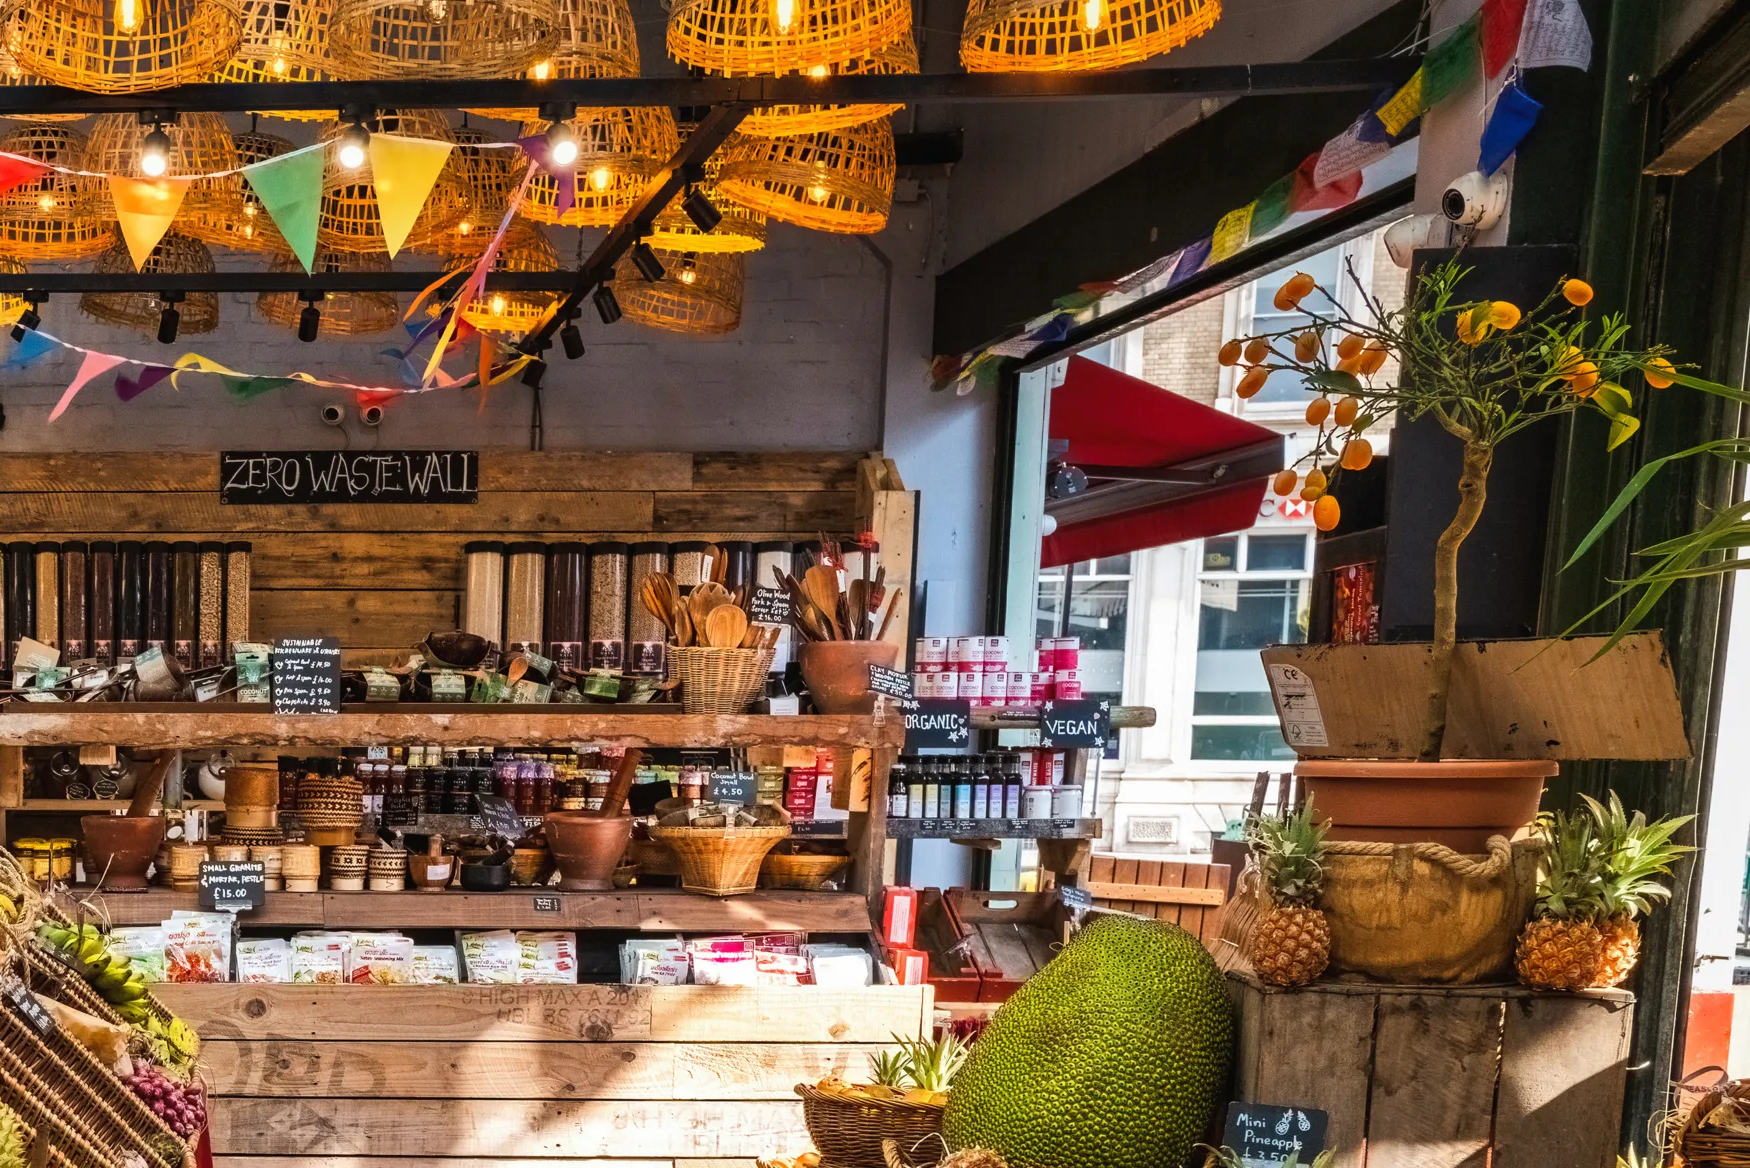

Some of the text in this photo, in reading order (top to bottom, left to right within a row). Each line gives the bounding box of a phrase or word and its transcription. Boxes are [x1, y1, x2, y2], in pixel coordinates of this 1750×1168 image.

[223, 452, 478, 497] ZERO WASTE WALL
[752, 597, 765, 605] Fork
[757, 589, 790, 600] Olive Wood
[905, 714, 959, 729] ORGANIC
[1045, 720, 1098, 735] VEGAN
[202, 863, 262, 872] SMALL GRANITE
[242, 875, 264, 883] PESTLE
[213, 887, 247, 900] £15.00
[480, 989, 529, 1004] HIGH
[538, 989, 580, 1005] MAX
[1236, 1113, 1266, 1128] Mini
[1244, 1129, 1303, 1151] Pineapple
